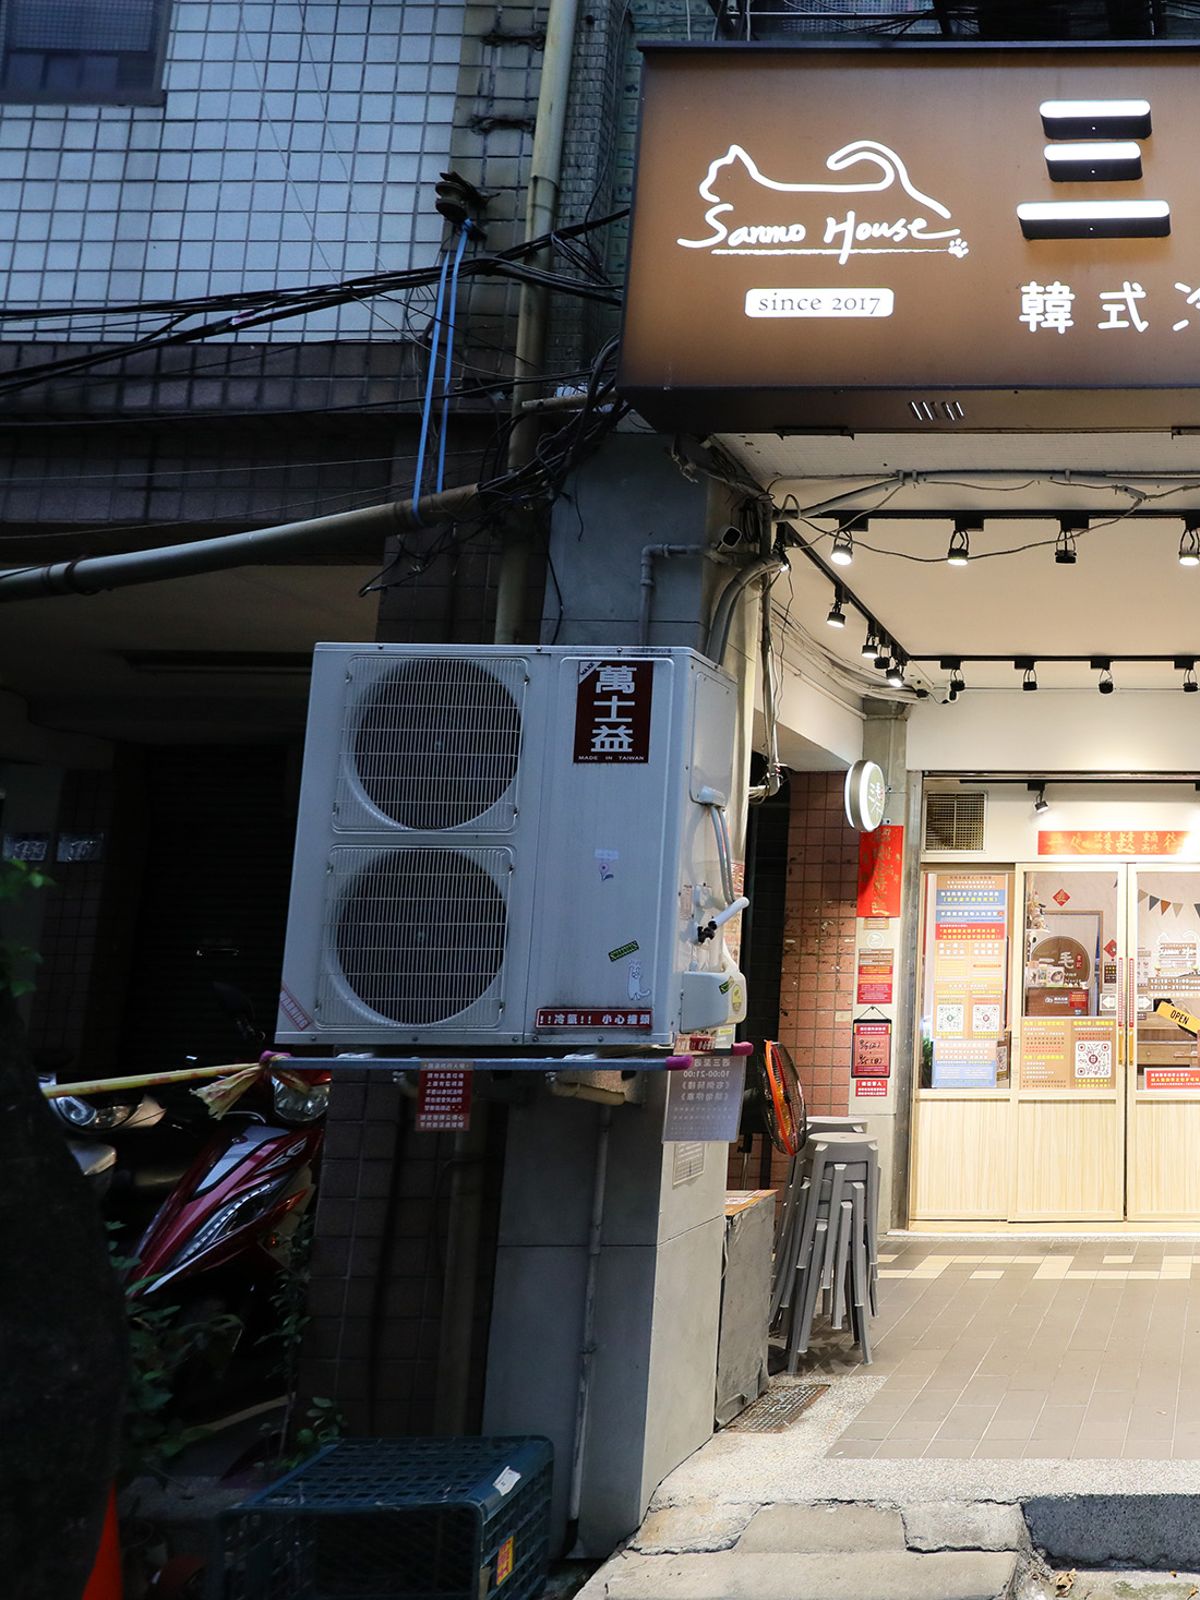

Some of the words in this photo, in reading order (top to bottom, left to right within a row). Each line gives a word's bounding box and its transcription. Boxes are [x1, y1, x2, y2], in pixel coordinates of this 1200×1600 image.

[677, 203, 806, 248] Sanmo
[823, 210, 960, 265] House
[758, 292, 822, 312] since
[831, 296, 881, 317] 2017
[591, 665, 637, 752] 萬士益
[1170, 1009, 1190, 1025] OPEN
